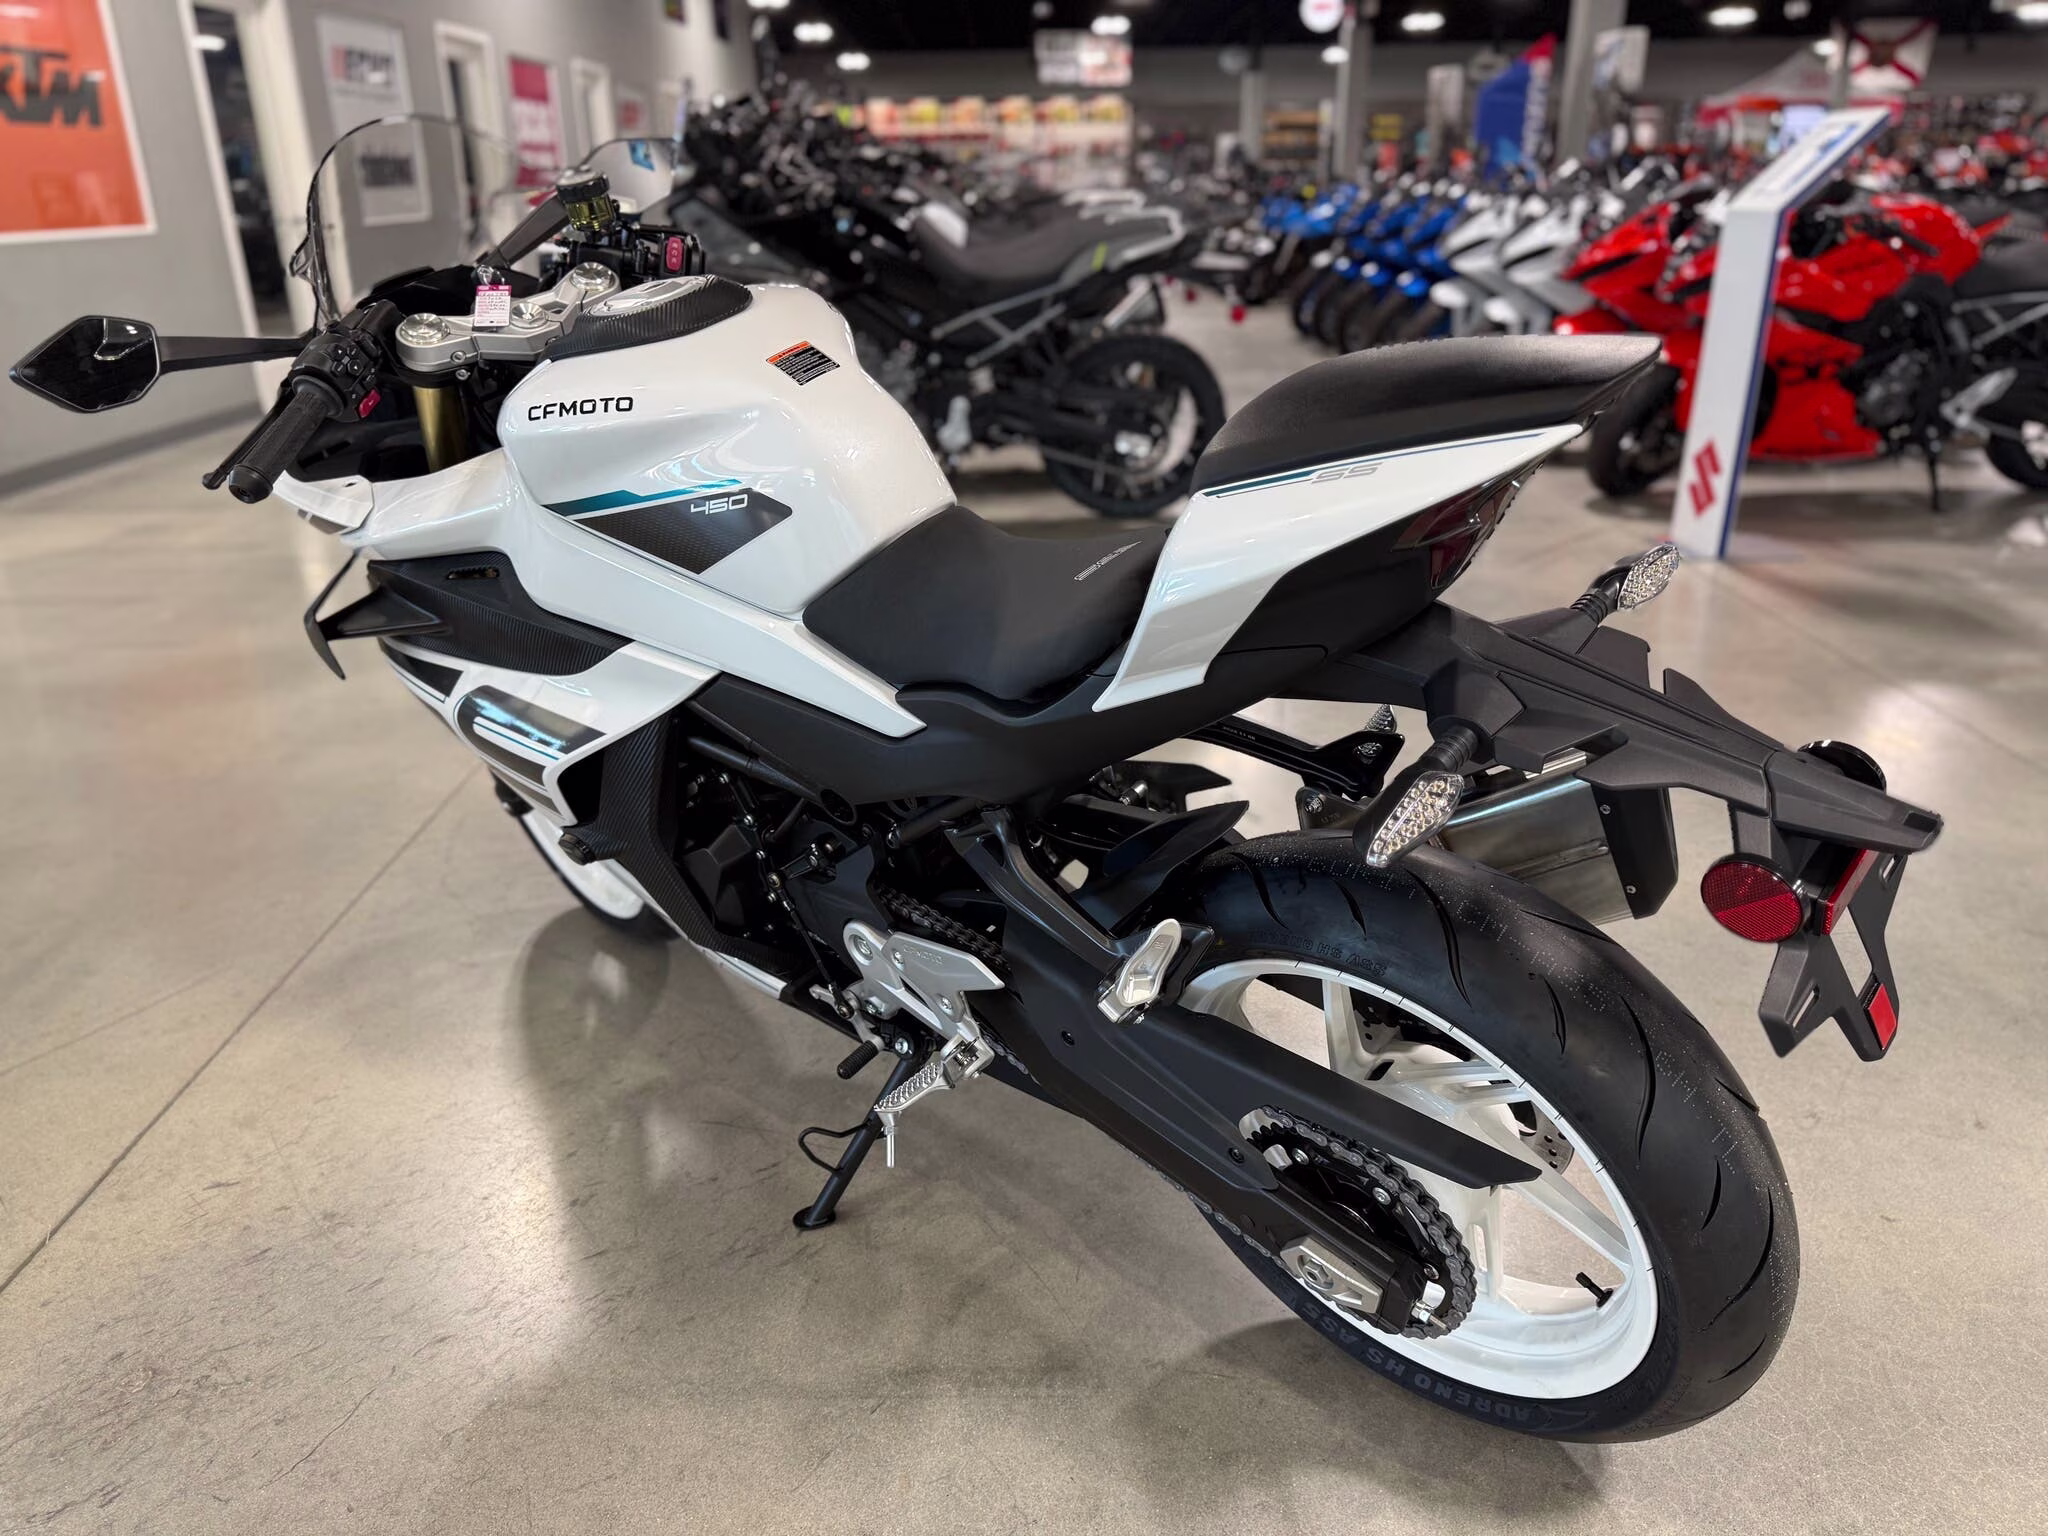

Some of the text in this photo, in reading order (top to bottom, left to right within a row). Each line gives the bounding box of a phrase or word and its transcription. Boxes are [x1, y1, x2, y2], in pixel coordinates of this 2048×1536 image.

[528, 397, 634, 421] CFMOTO
[1310, 462, 1384, 484] SS
[690, 494, 749, 515] 450
[1366, 1346, 1406, 1378] HS
[1414, 1372, 1531, 1422] ADRENO
